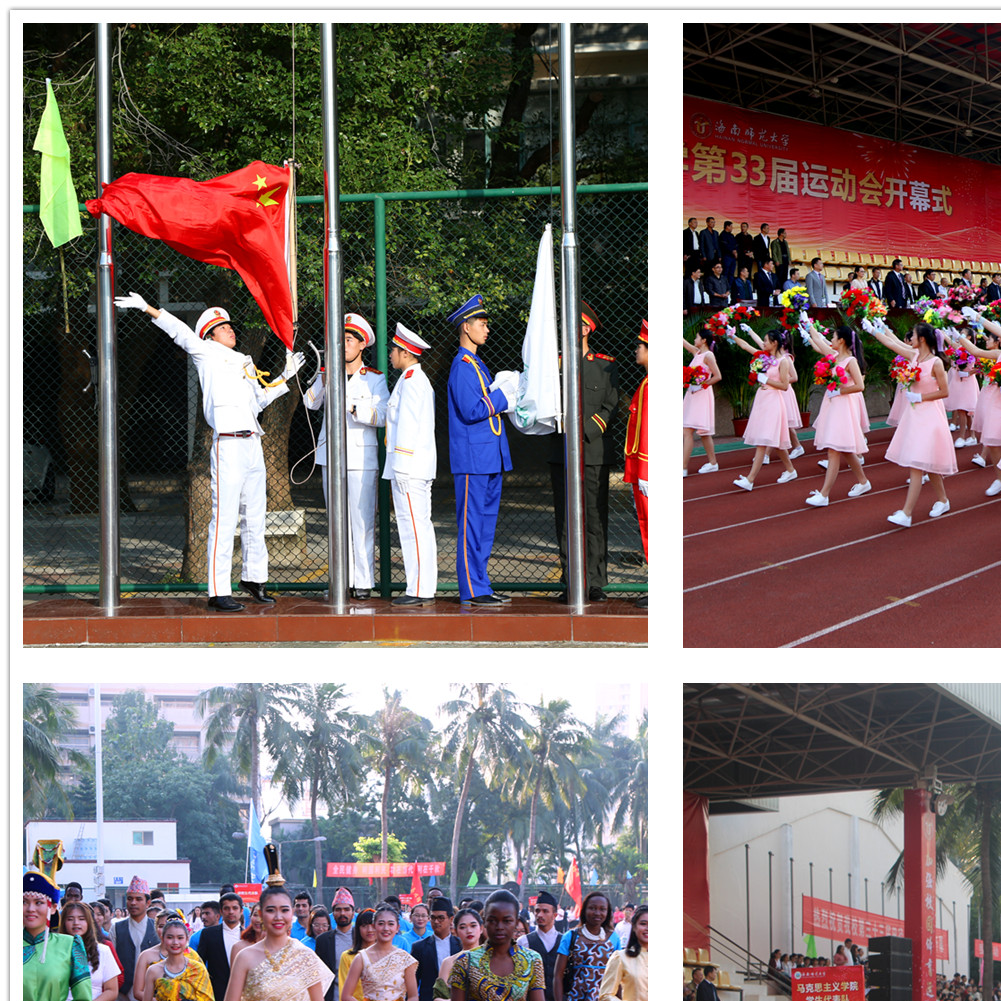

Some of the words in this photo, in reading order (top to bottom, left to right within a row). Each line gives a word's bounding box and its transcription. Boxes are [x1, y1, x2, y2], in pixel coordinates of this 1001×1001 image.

[683, 142, 953, 216] 第33届运动会开幕式
[797, 981, 859, 993] 马克思主义学院
